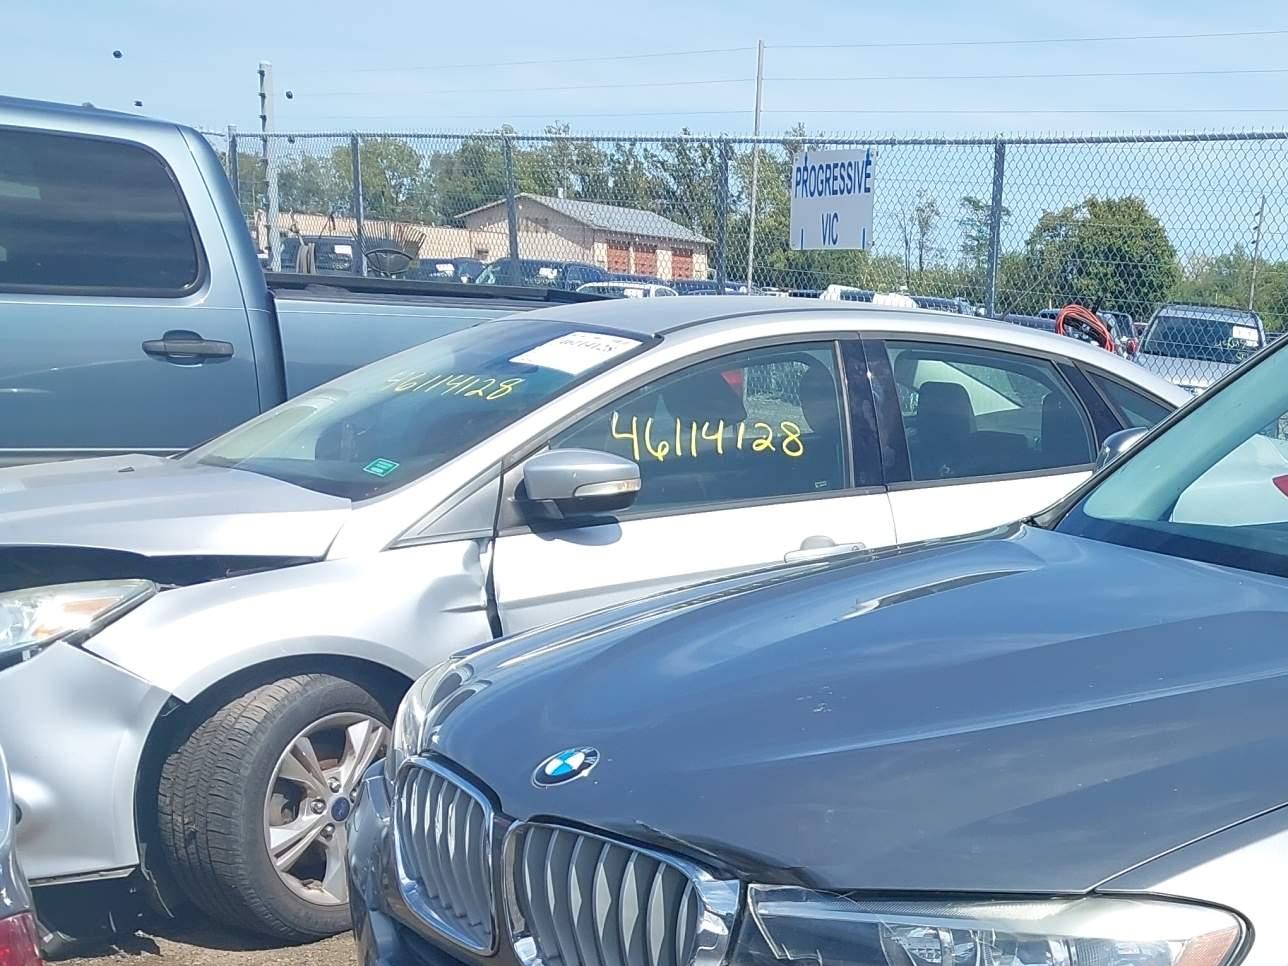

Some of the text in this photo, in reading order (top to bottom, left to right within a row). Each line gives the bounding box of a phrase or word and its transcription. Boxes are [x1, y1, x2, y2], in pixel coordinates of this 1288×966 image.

[795, 160, 872, 198] PROGRESSIVE
[821, 212, 839, 246] VIC
[611, 411, 804, 462] 46114128
